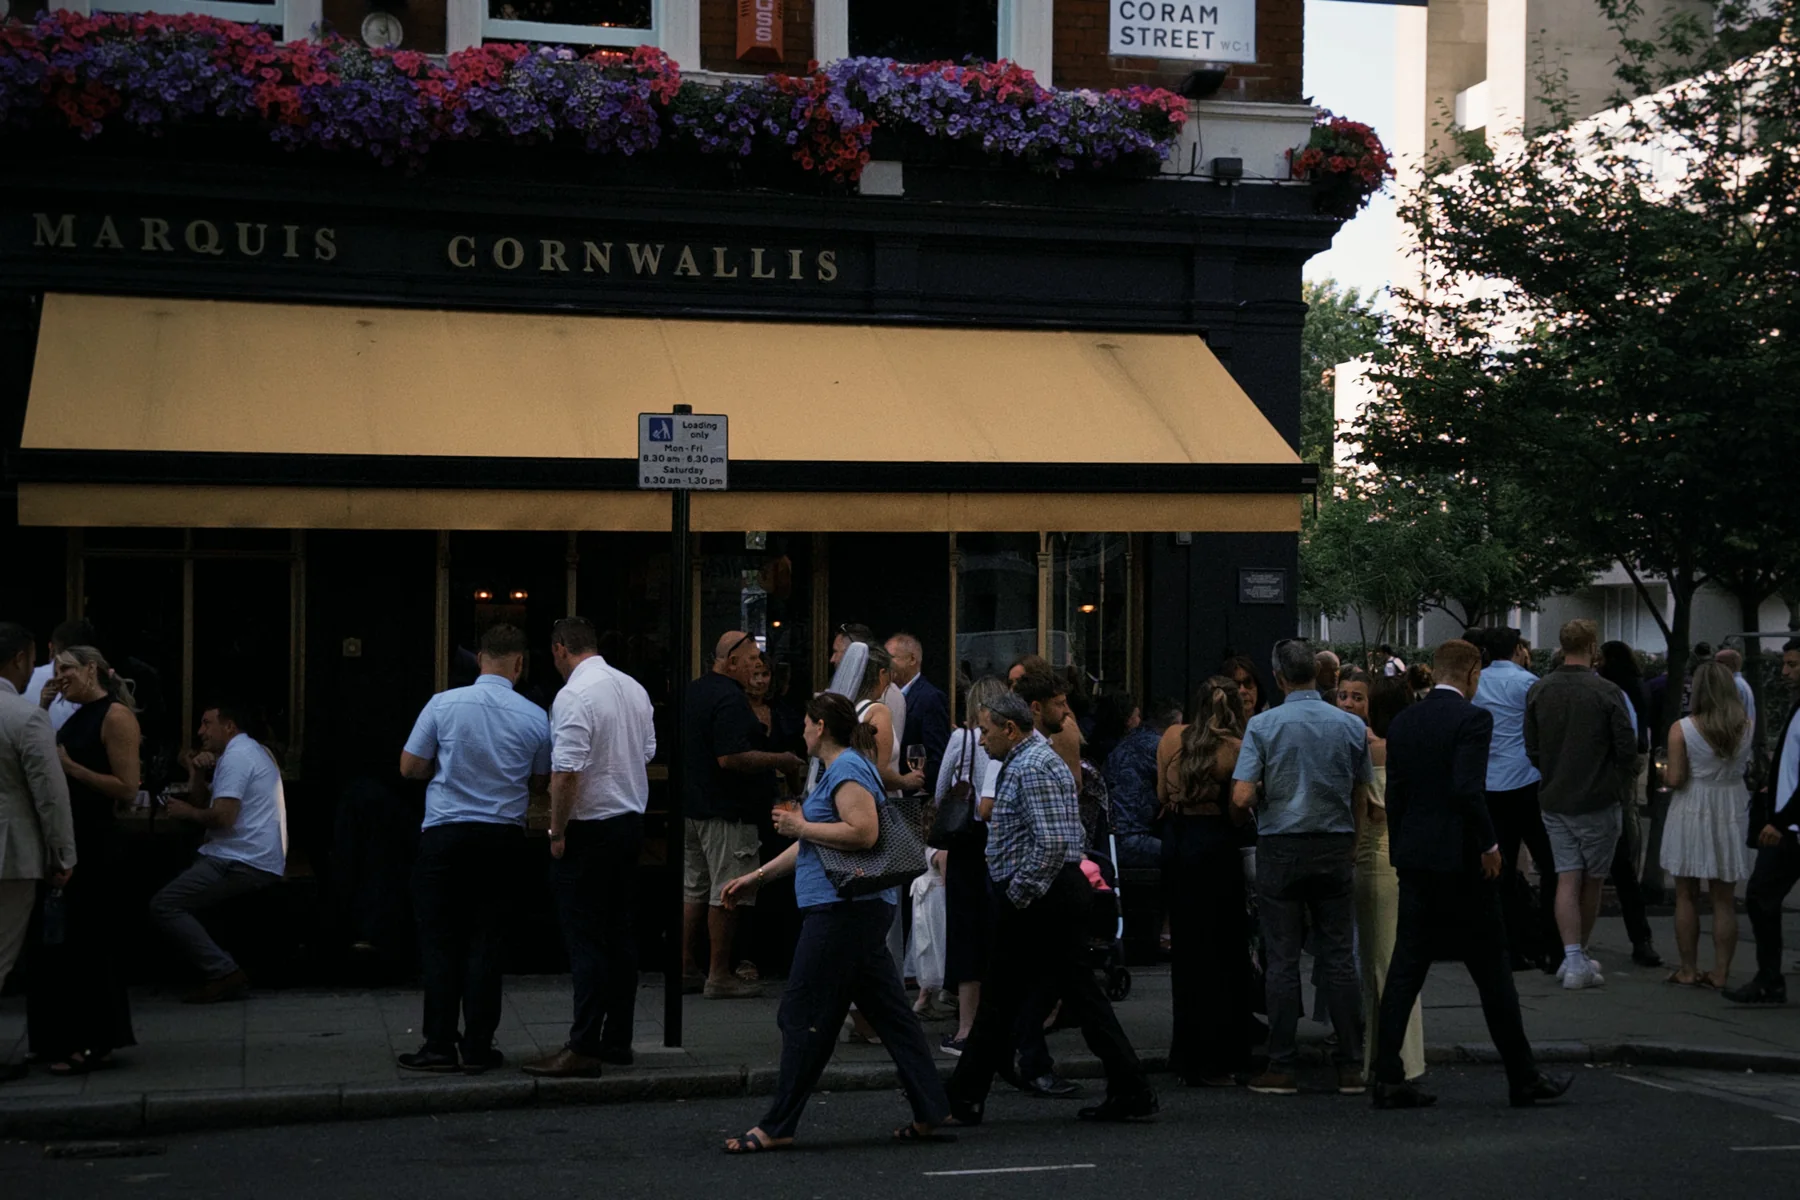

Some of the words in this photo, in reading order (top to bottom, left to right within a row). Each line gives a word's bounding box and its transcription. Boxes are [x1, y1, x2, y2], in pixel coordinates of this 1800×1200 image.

[1119, 0, 1218, 25] CORAM
[1120, 26, 1215, 50] STREET
[1220, 41, 1250, 51] WC1
[32, 212, 338, 261] MARQUIS
[447, 235, 839, 281] CORNWALLIS
[682, 421, 717, 430] Loading
[690, 431, 709, 439] only
[664, 444, 684, 452] Mon
[691, 444, 703, 452] Fri
[643, 454, 665, 463] 8.30
[687, 455, 708, 463] 6.30
[663, 465, 704, 475] Saturday
[644, 476, 666, 484] 8.30
[688, 476, 708, 484] 1.30
